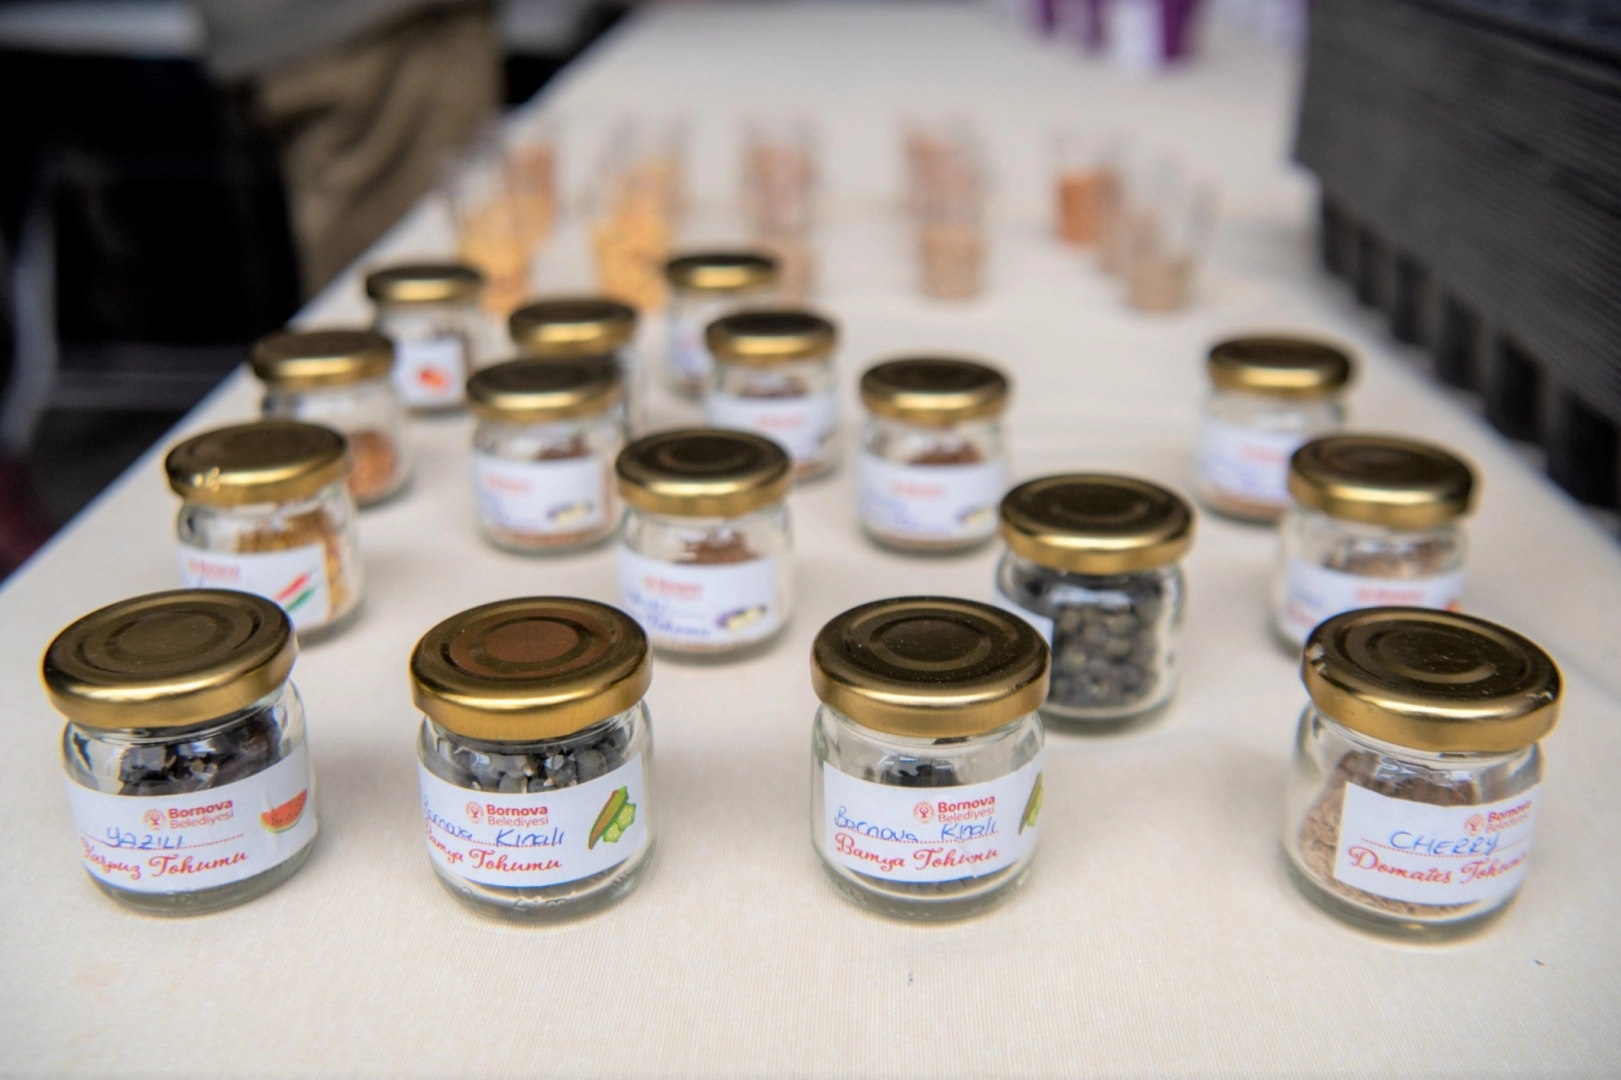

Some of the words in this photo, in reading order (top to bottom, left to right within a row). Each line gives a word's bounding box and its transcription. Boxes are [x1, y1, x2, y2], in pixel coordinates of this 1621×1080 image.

[168, 800, 234, 819] Bornova
[487, 804, 548, 817] Bornova
[938, 796, 996, 813] Bornova
[170, 809, 234, 829] Belediyesi
[487, 816, 549, 828] Belediyesi
[938, 807, 995, 823] Belediyesi
[835, 832, 906, 872] Bamya
[913, 847, 1000, 870] Tohumu
[1390, 831, 1500, 857] CHERRY
[148, 851, 249, 878] Tohumu
[469, 849, 562, 872] Tohumu
[1348, 845, 1452, 884] Domates
